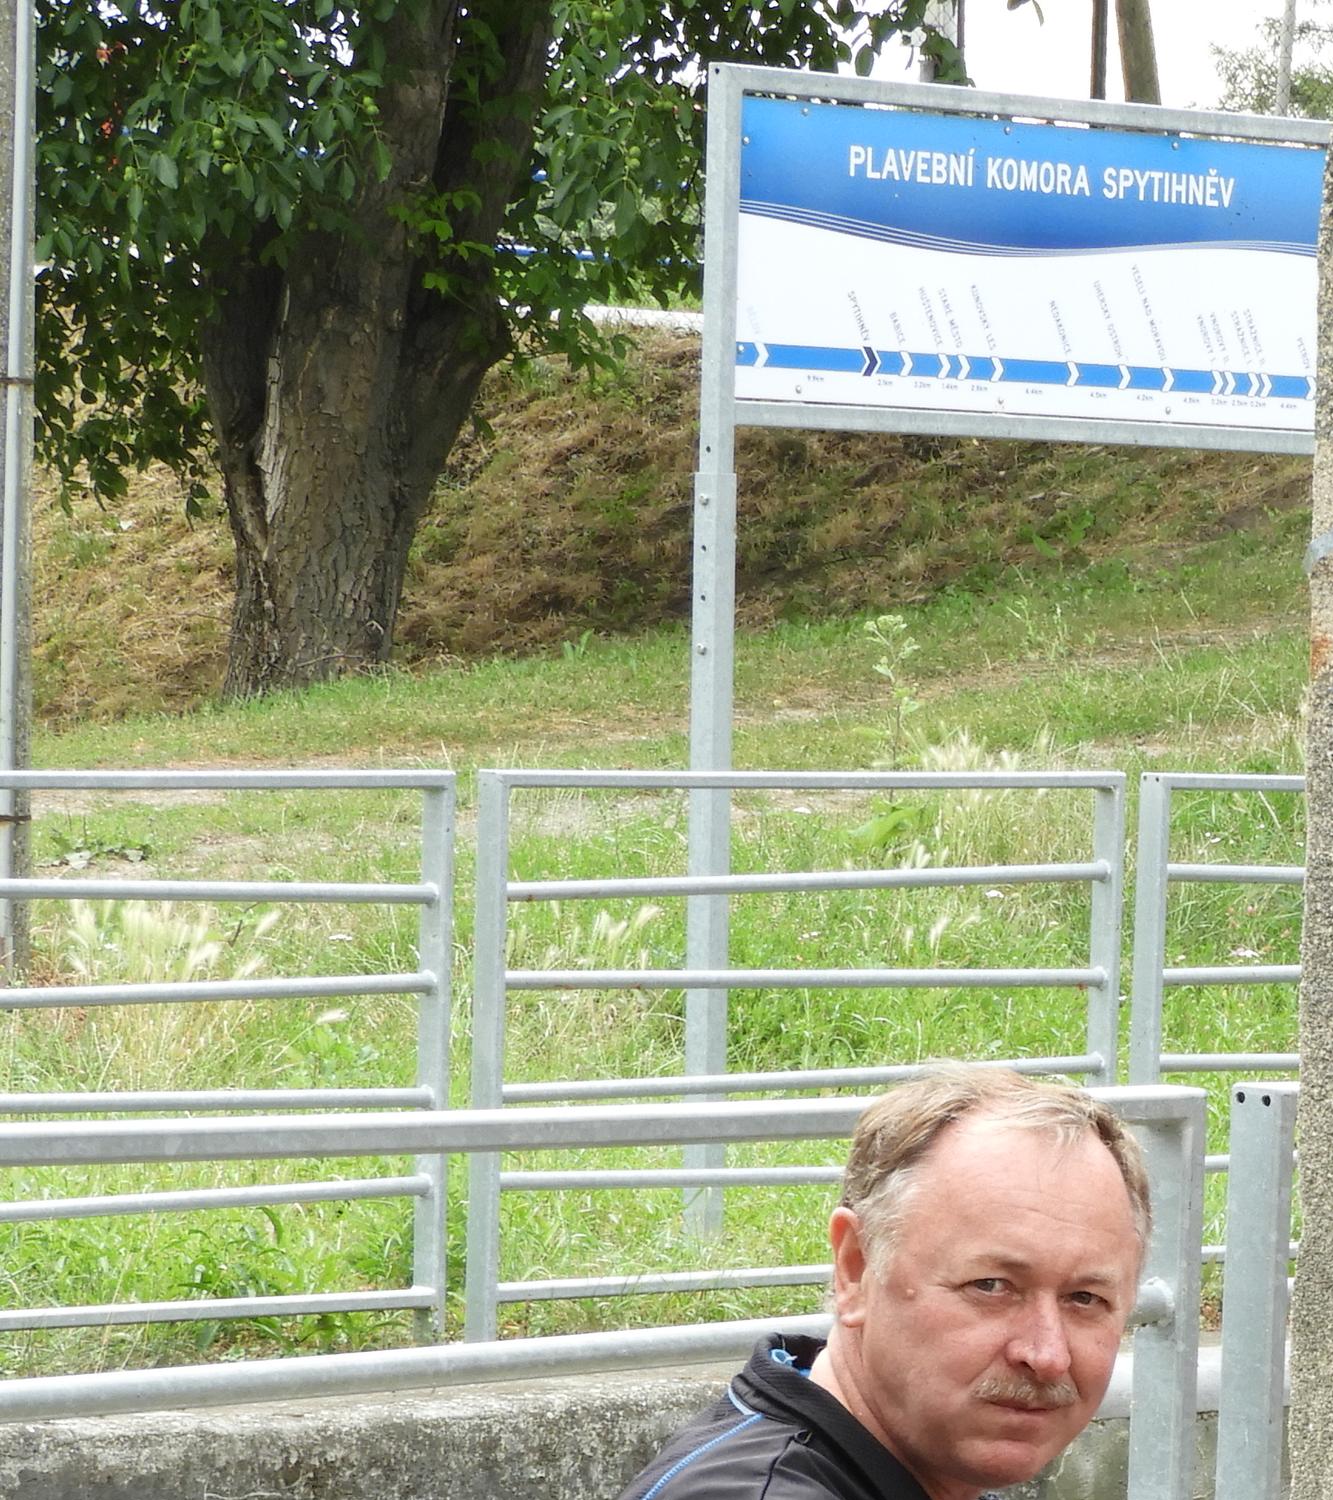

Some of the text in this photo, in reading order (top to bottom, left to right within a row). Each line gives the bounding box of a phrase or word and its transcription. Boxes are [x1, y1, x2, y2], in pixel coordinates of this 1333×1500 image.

[849, 145, 1235, 209] PLAVEBNÍ KOMORA SPYTIHNĚV
